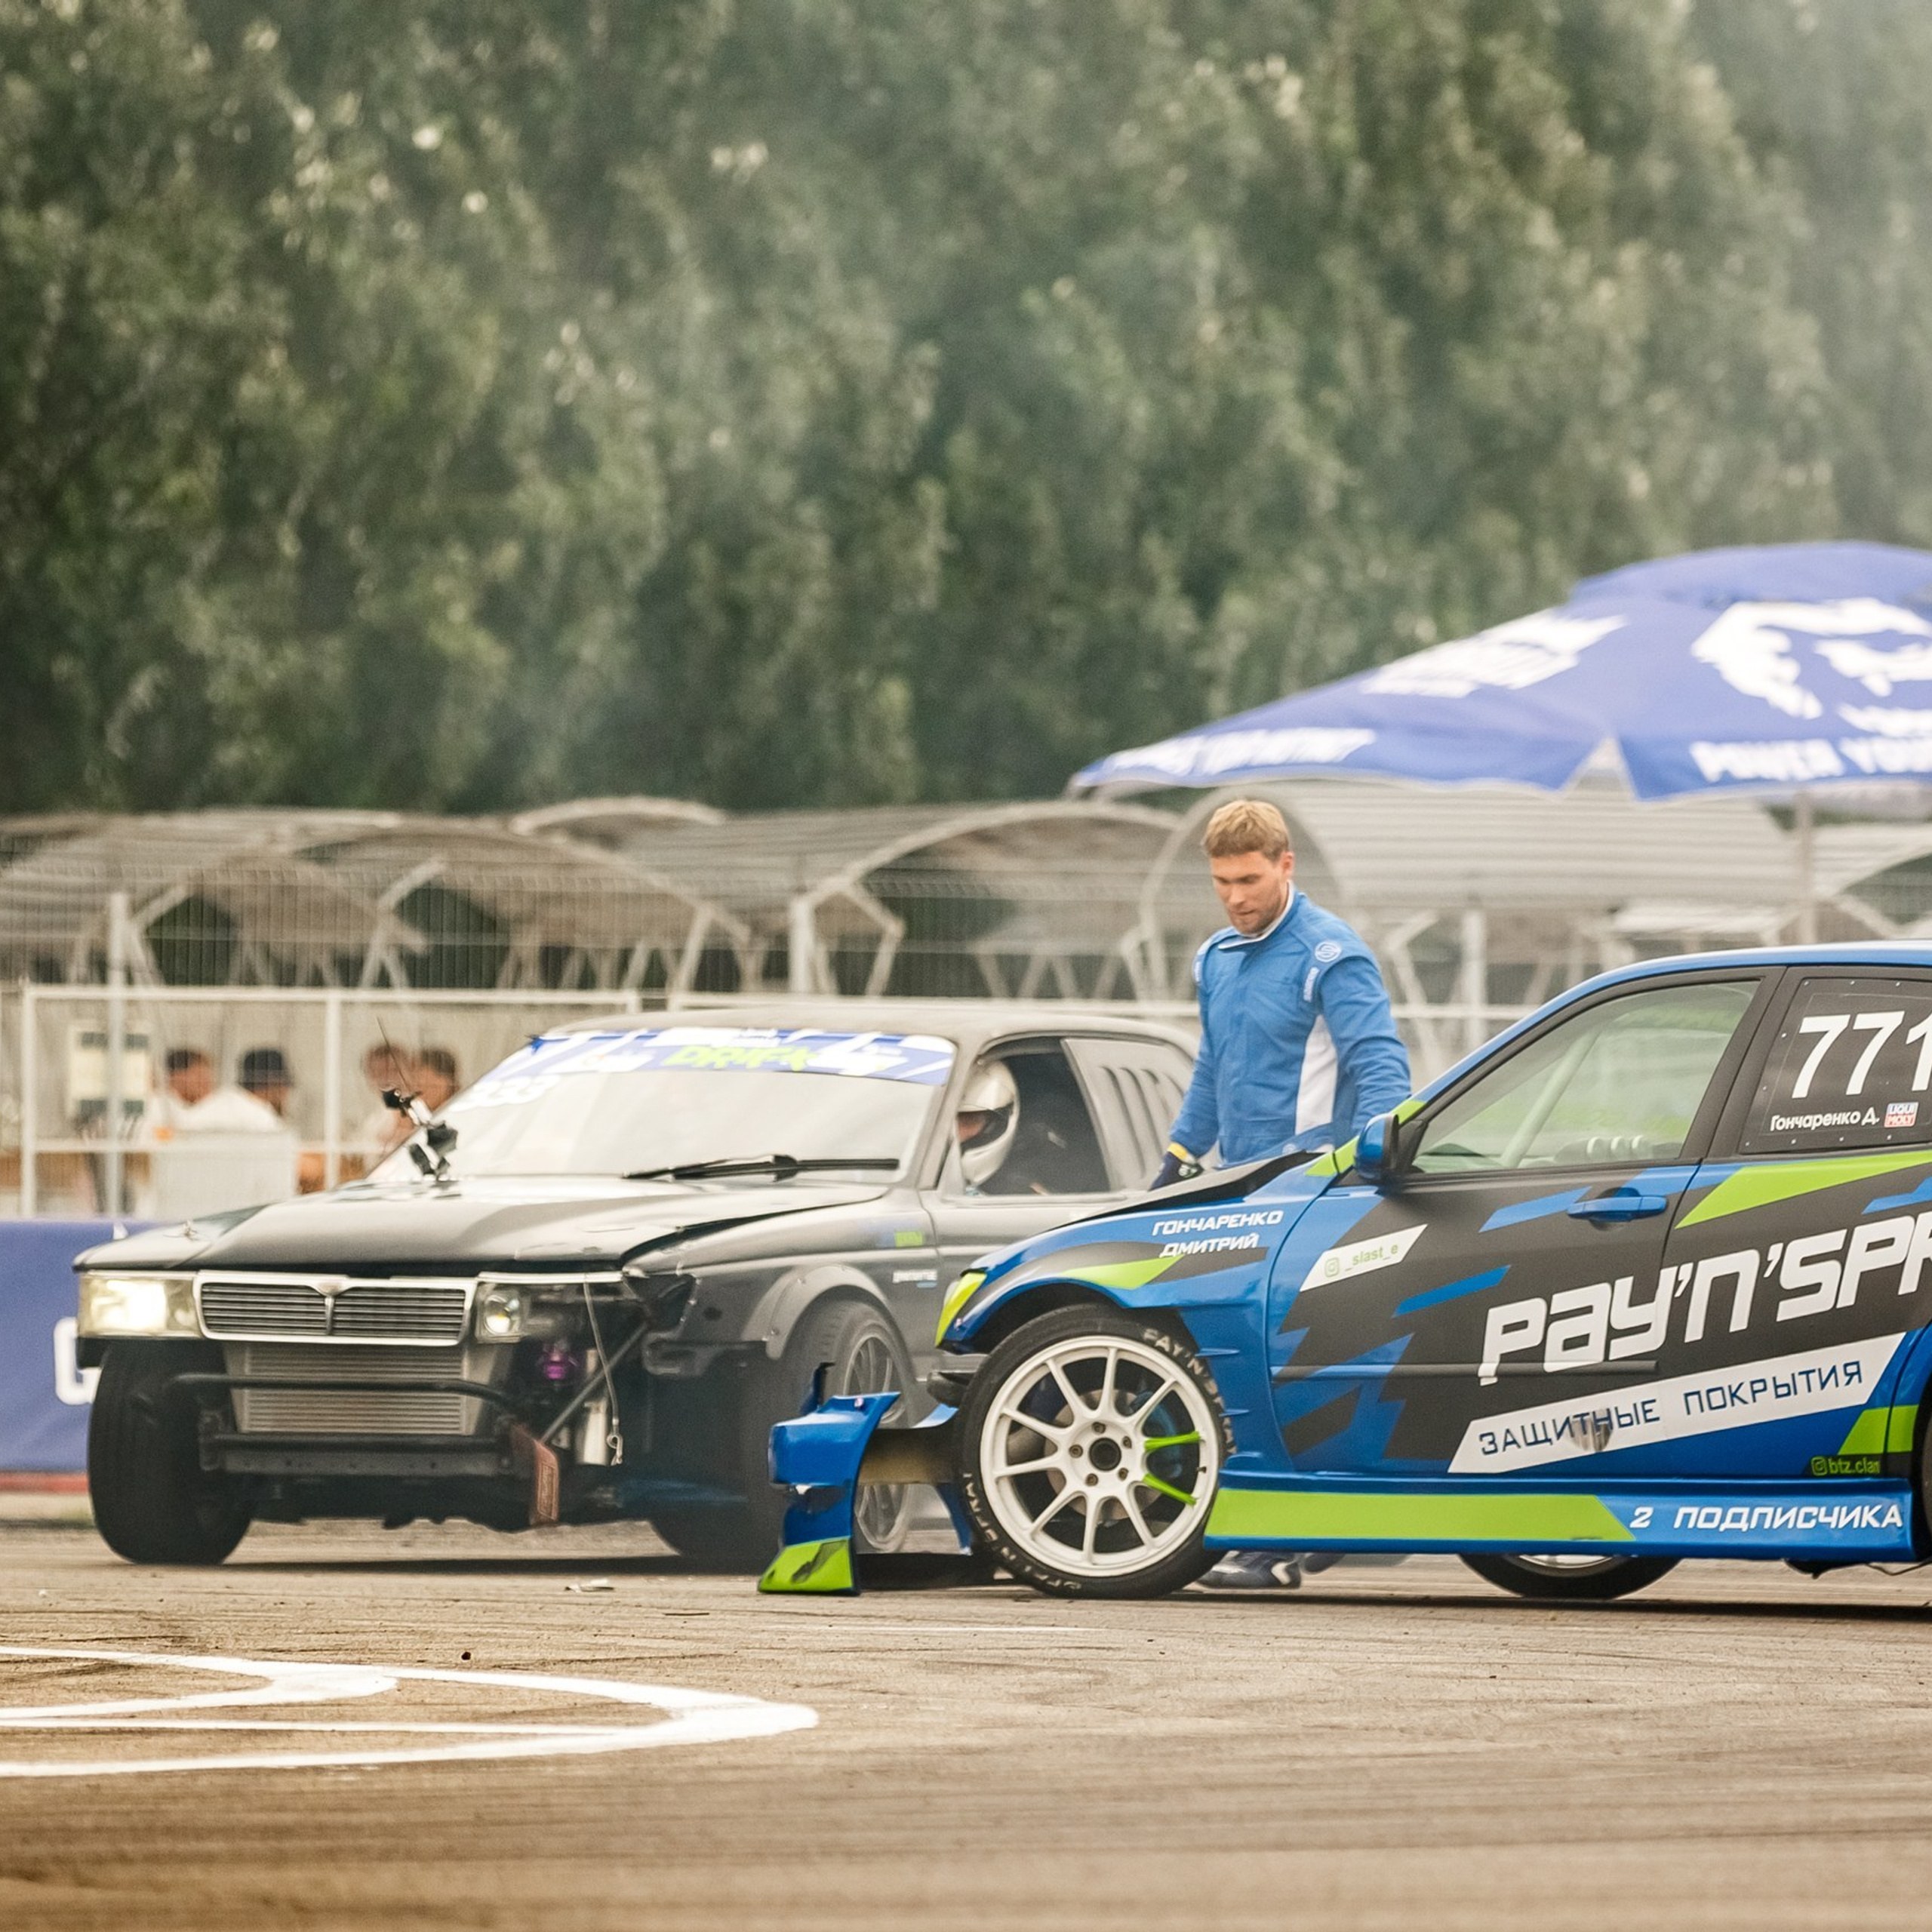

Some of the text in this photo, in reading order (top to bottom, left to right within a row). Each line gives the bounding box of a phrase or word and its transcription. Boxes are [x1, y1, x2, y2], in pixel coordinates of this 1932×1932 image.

[1792, 1011, 1932, 1099] 771
[1770, 1106, 1880, 1131] Гончаренко Д.
[1152, 1210, 1284, 1236] ГОНЧАРЕНКО
[1158, 1232, 1260, 1258] ДМИТРИЙ
[1478, 1360, 1863, 1456] ЗАЩИТНЫЕ ПОКРЫТИЯ
[1629, 1504, 1903, 1532] 2 ПОДПИСЧИКА
